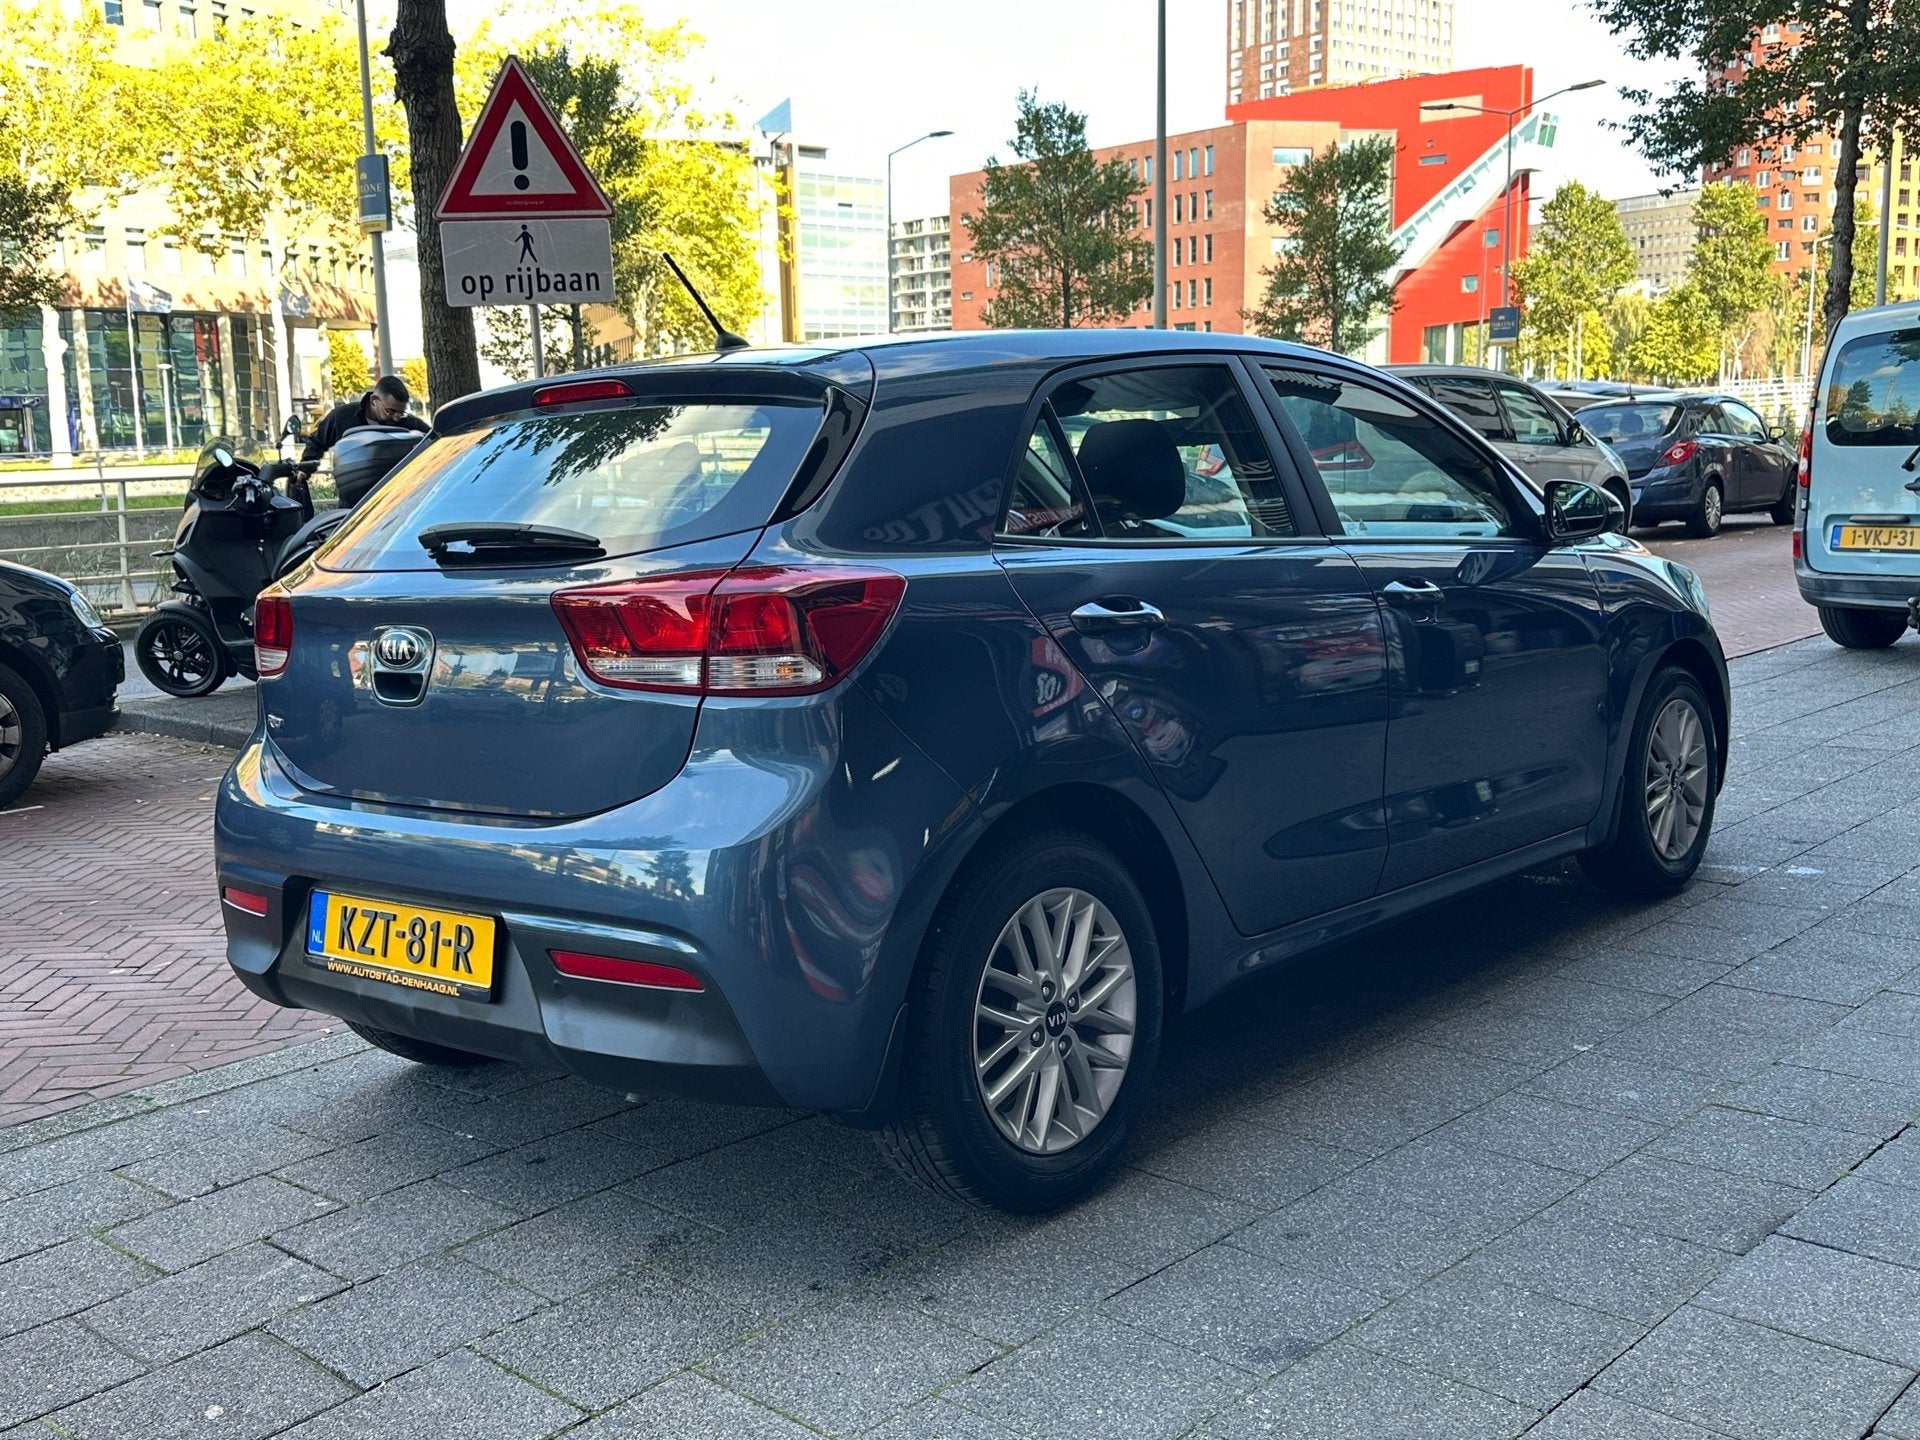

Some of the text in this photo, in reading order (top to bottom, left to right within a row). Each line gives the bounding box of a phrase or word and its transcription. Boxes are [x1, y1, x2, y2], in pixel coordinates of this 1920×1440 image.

[461, 266, 600, 301] op rijbaan
[1851, 529, 1915, 547] 1-VKJ-31
[382, 639, 411, 660] KIA
[311, 929, 323, 944] NL
[338, 905, 475, 974] KZT-81-R
[327, 961, 460, 997] WWW.AUTOSTAD-DENHAAG.NL
[1048, 1011, 1067, 1027] KIA
